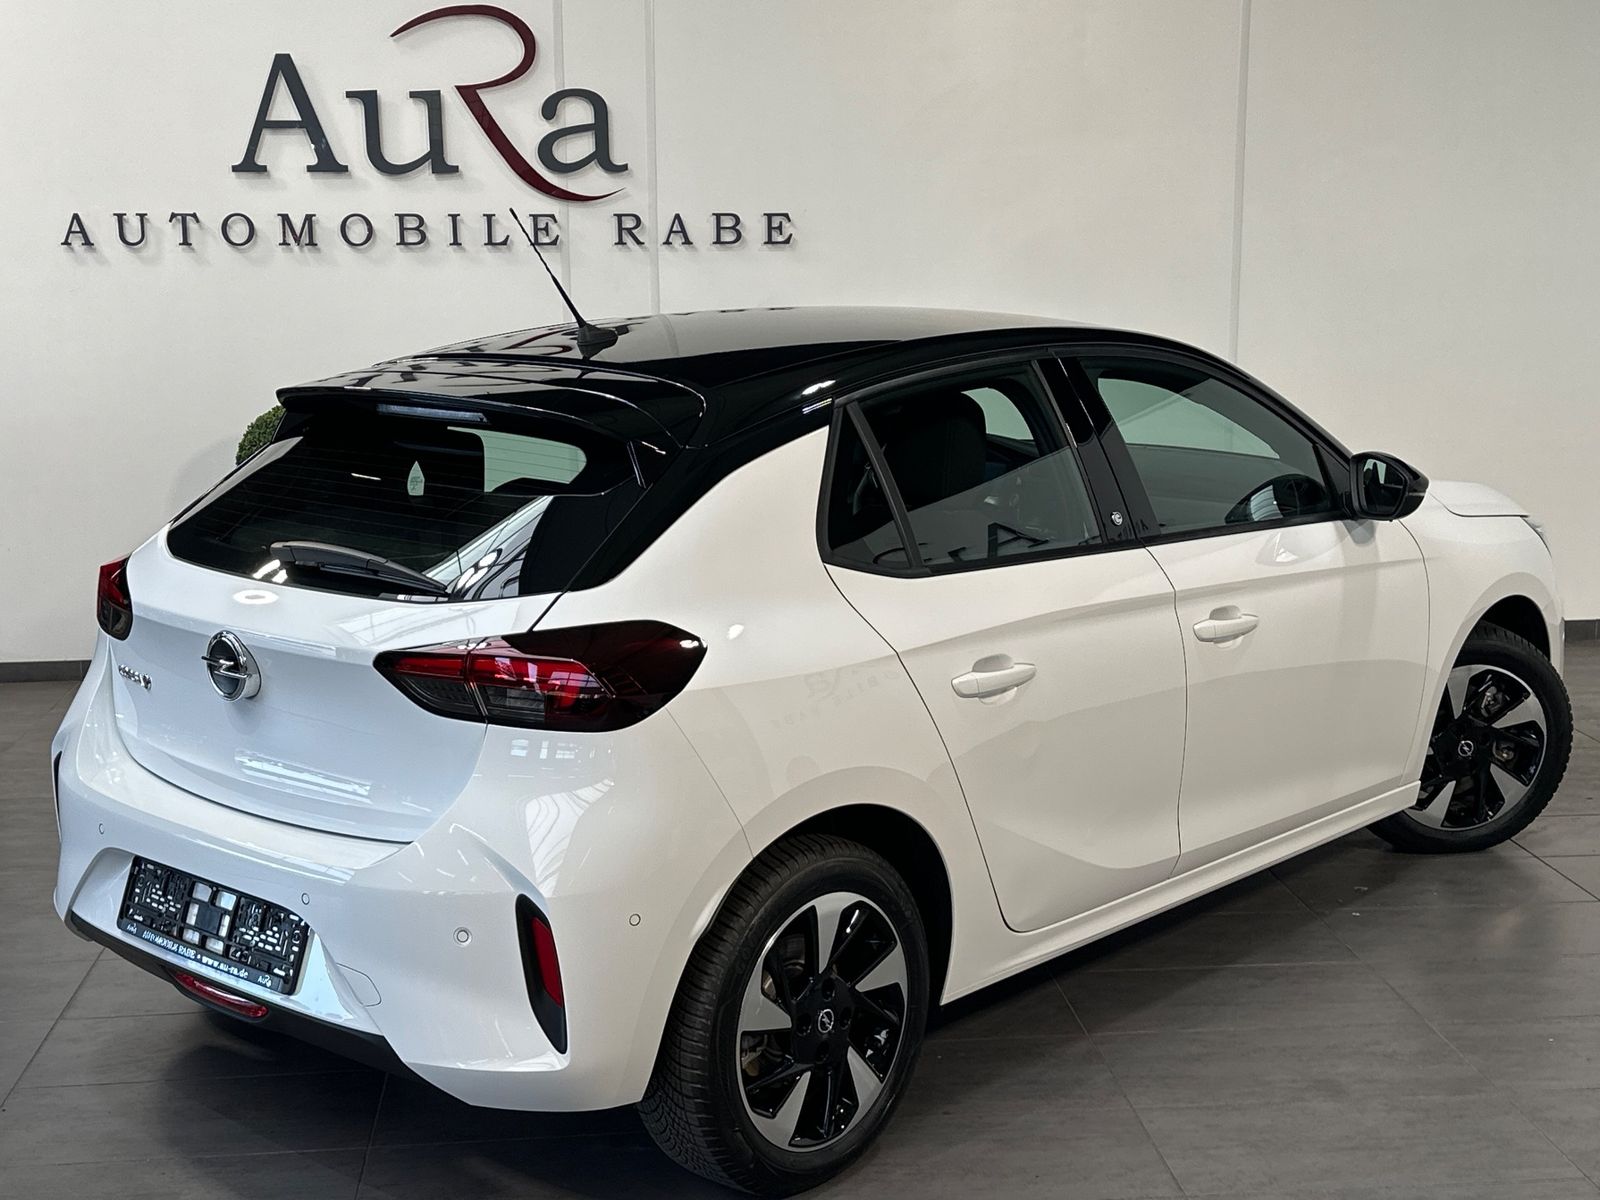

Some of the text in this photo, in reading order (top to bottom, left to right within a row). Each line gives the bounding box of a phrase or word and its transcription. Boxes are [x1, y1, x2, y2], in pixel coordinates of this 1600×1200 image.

[231, 4, 629, 203] AuRa
[61, 212, 796, 248] AUTOMOBILE RABE
